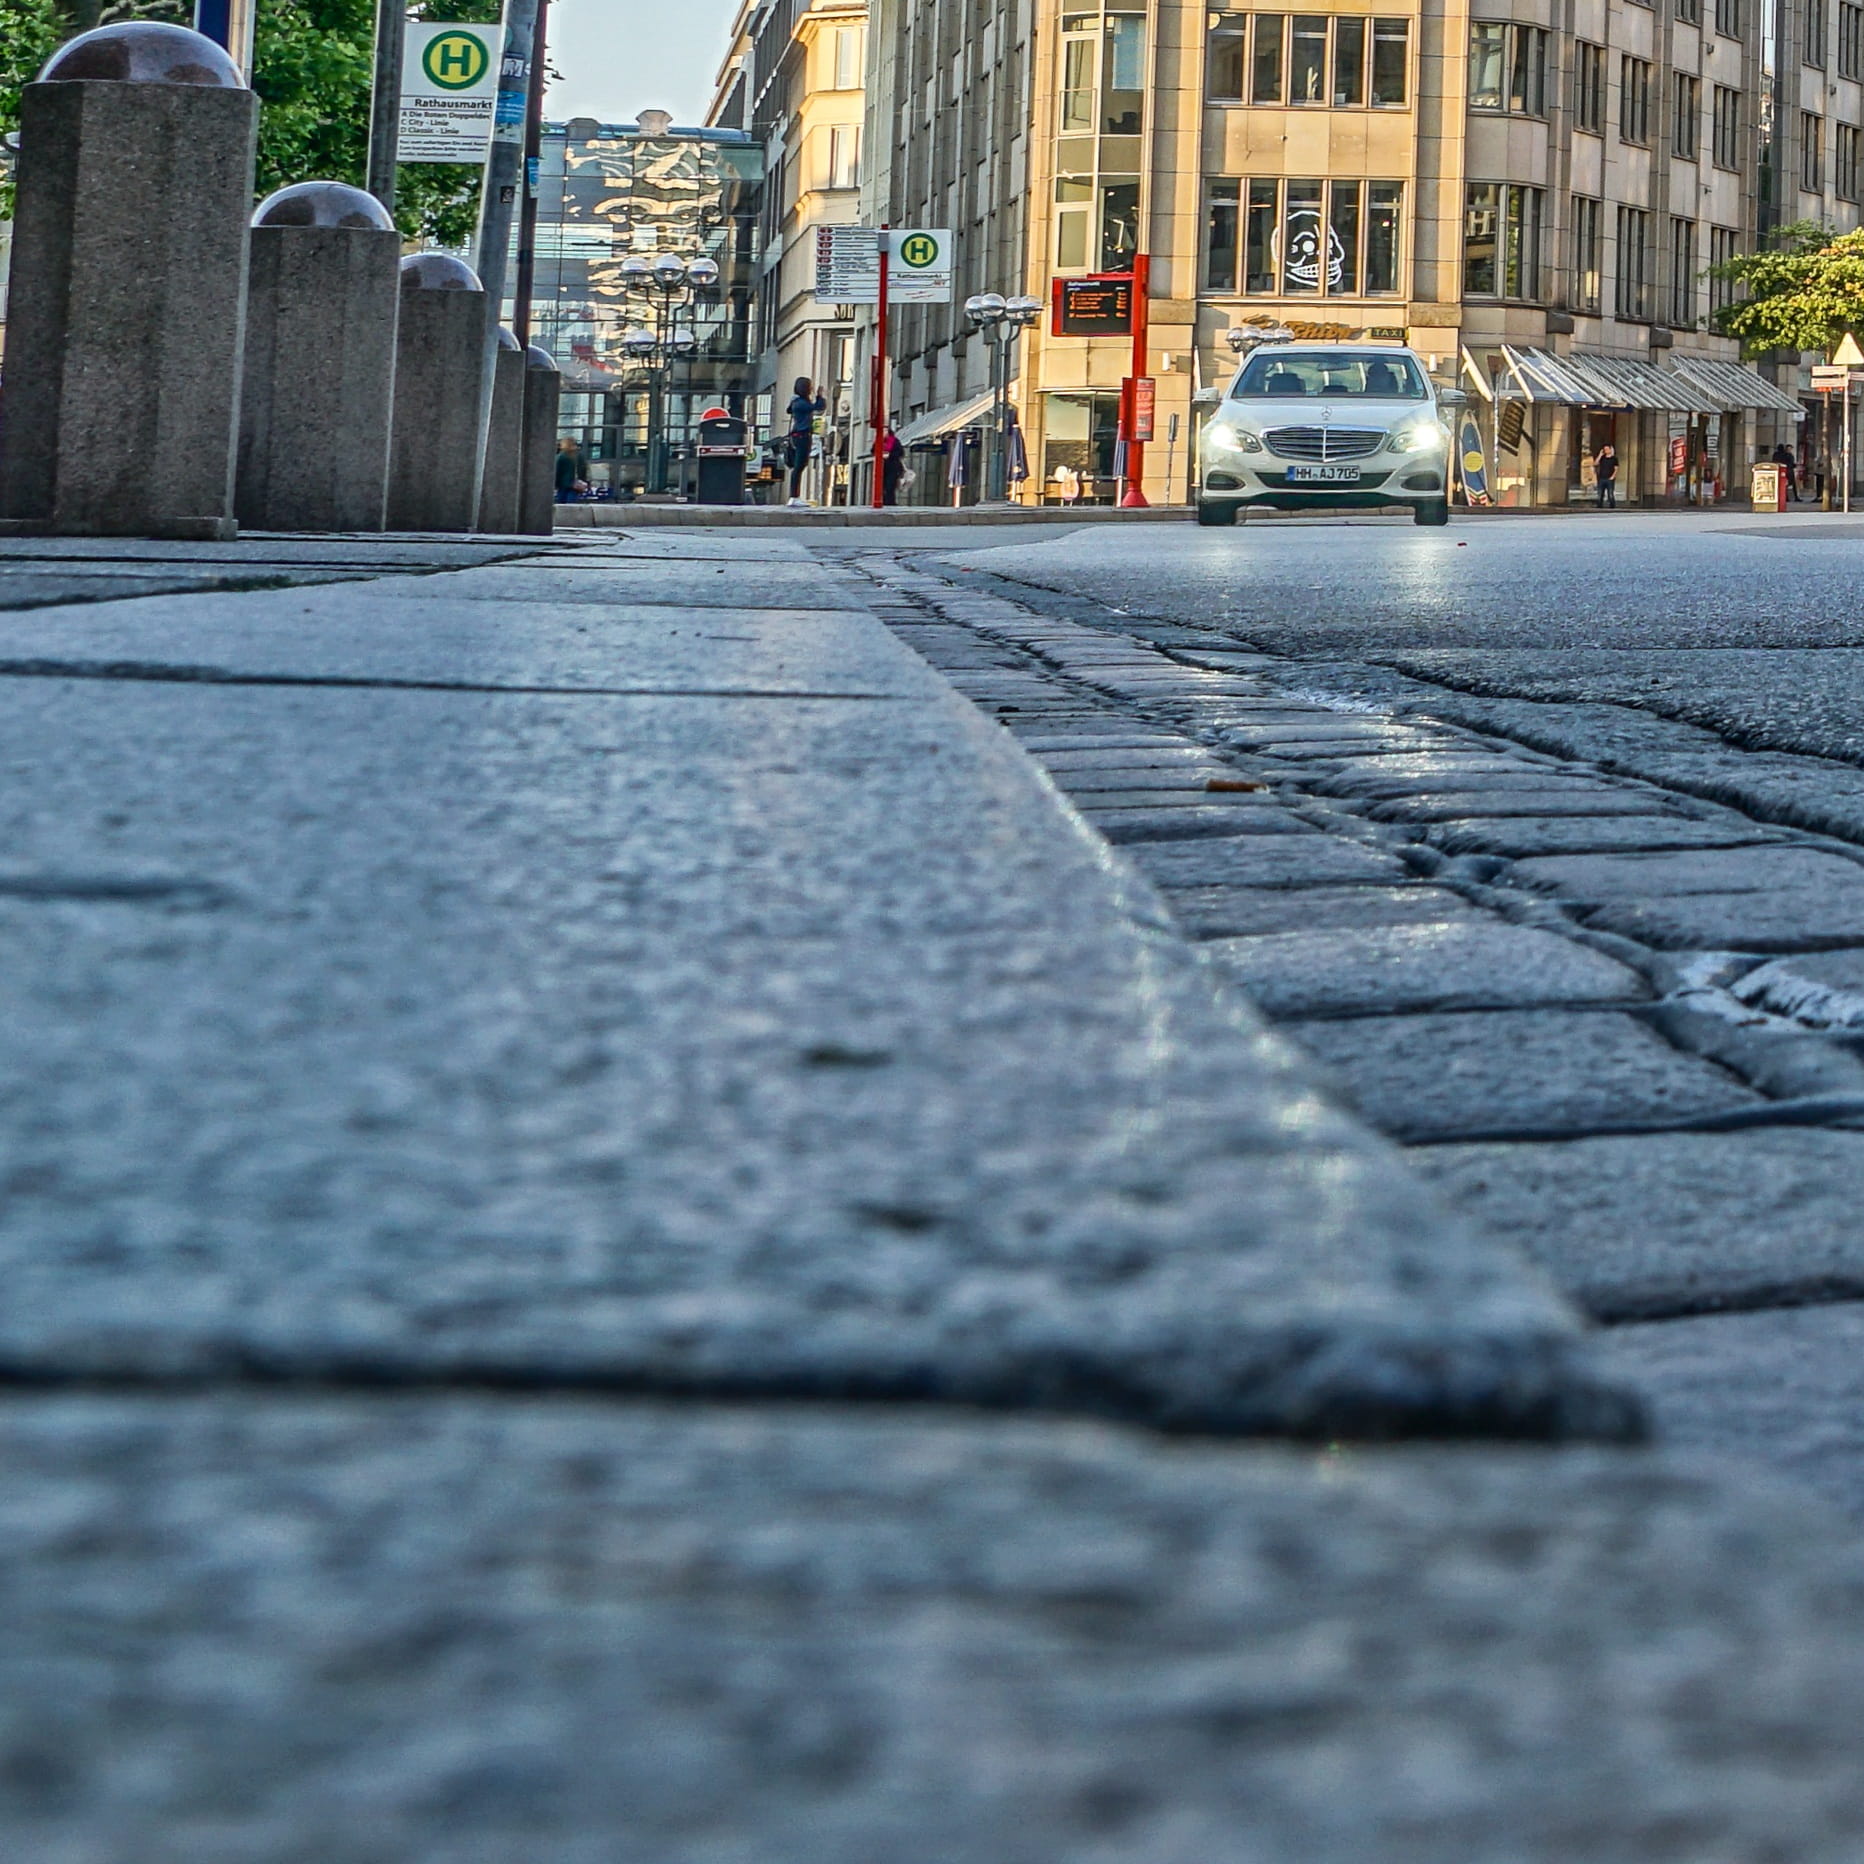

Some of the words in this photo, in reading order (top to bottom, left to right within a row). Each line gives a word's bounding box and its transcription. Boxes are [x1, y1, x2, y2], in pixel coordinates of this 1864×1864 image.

[440, 44, 471, 76] H
[414, 98, 493, 110] Rathausmarkt
[911, 241, 929, 260] H
[1374, 328, 1403, 338] TAXI
[1295, 468, 1312, 479] HH
